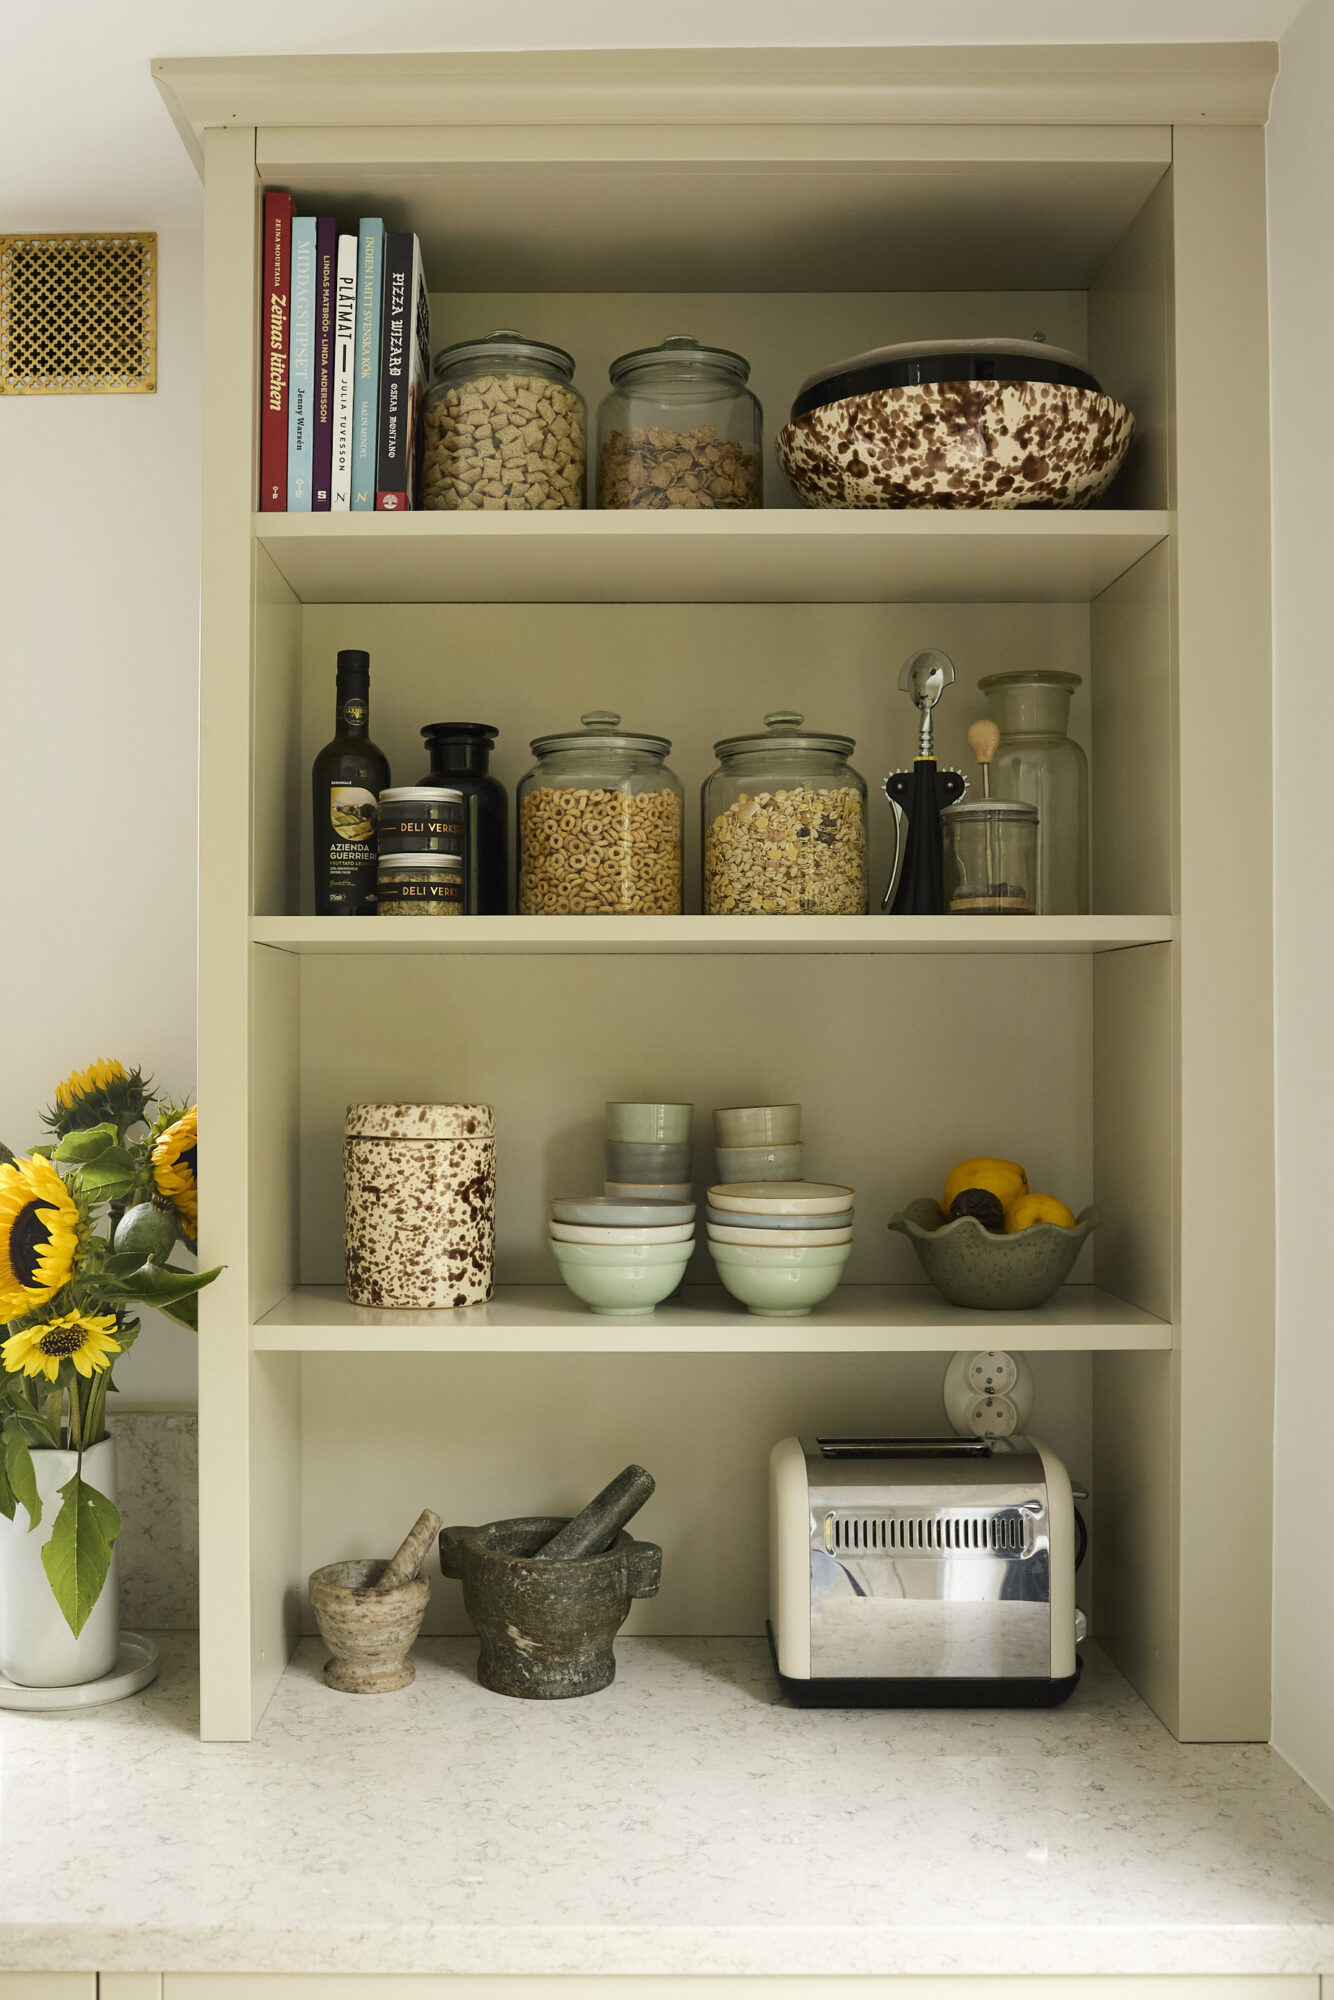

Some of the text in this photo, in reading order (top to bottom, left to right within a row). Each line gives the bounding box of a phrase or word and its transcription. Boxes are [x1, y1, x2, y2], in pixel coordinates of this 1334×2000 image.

[365, 236, 374, 273] INDIEN
[296, 240, 310, 379] MIDDAGSTIPSET
[338, 277, 356, 340] PLÅTMAT
[364, 282, 373, 306] MITT
[270, 293, 287, 411] Zeinas kitchen
[320, 255, 331, 423] LINDAS MATBRÖD LINDA ANDERSSON
[362, 309, 373, 354] SVENSKA
[390, 272, 405, 376] PIZZA WIZARD
[361, 356, 371, 379] KÖK
[296, 388, 305, 451] Jenny Warsén
[339, 416, 347, 471] TUVESSON
[360, 401, 369, 459] MALIN MENDEL
[389, 383, 398, 459] OSKAR MONTANO
[330, 843, 370, 852] AZIENDA
[400, 822, 424, 832] DELI
[402, 886, 426, 896] DELI
